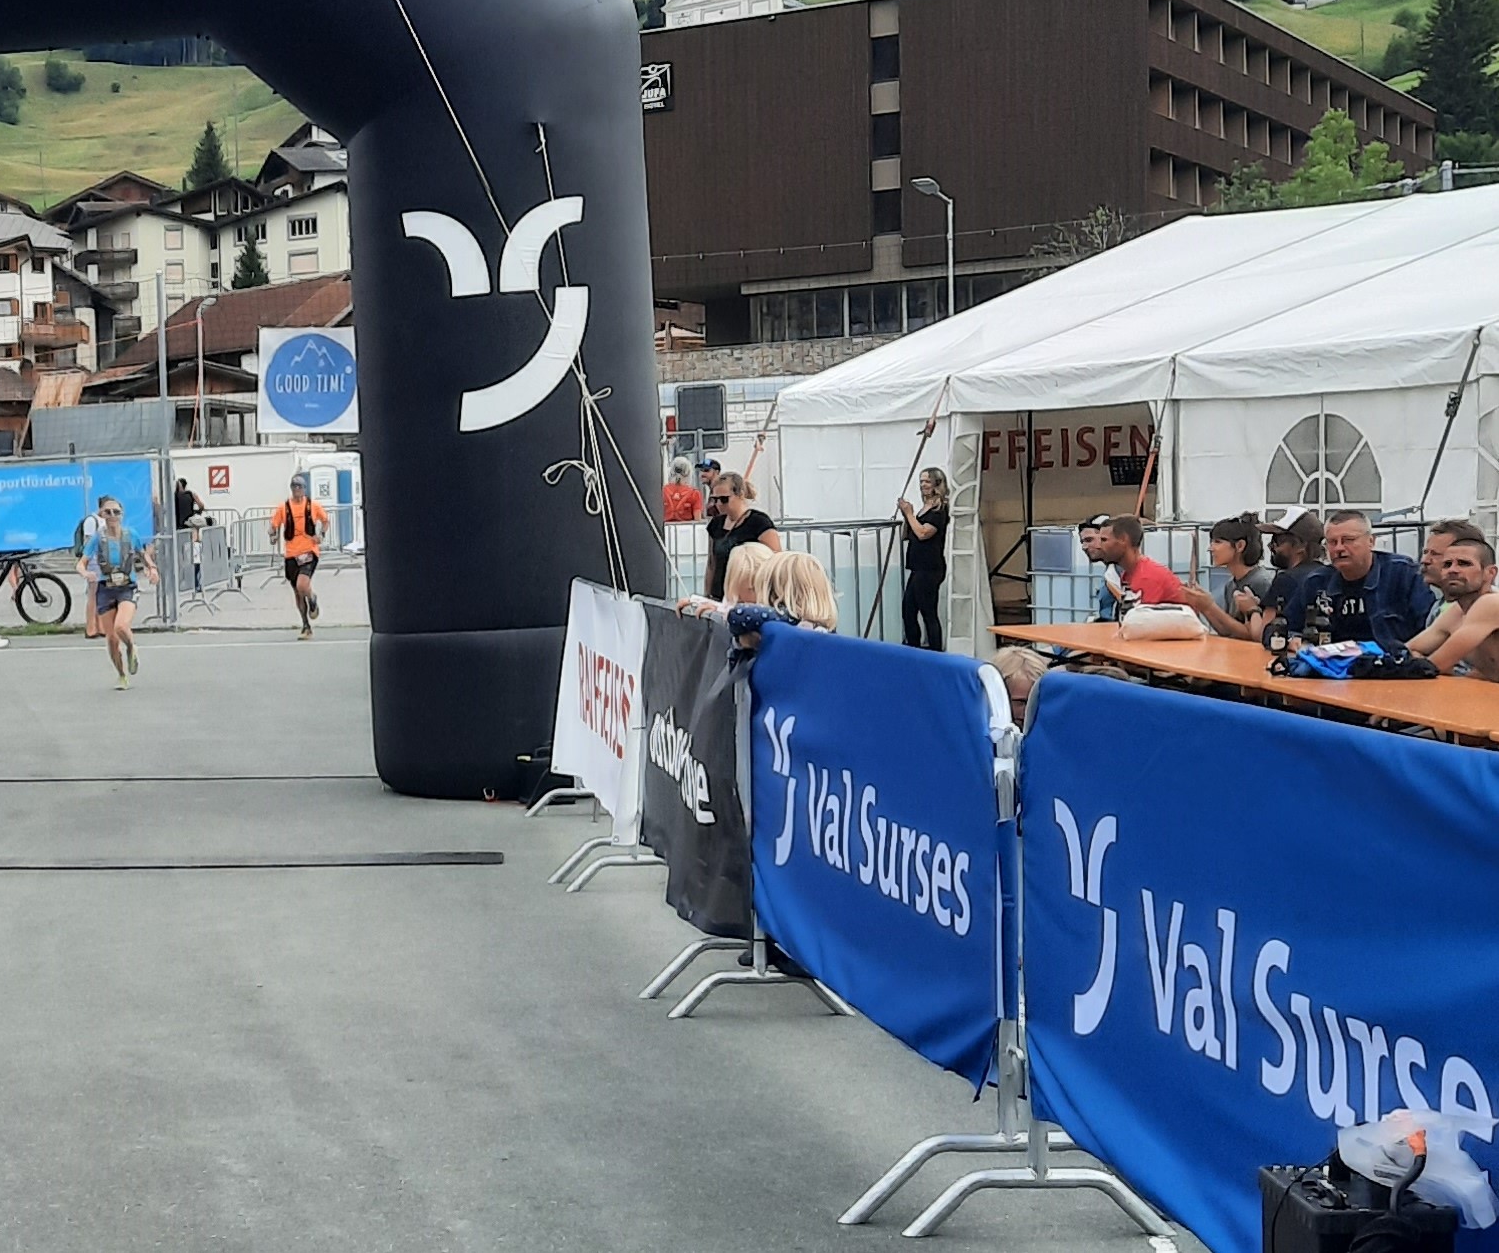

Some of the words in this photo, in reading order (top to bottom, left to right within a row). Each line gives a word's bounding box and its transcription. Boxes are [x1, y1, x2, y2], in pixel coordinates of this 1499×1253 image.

[275, 373, 310, 393] GOOD
[317, 373, 346, 393] TIME
[807, 762, 852, 874] Val
[859, 785, 971, 936] Surses
[1141, 887, 1238, 1071] Val
[1254, 939, 1499, 1144] Surse
